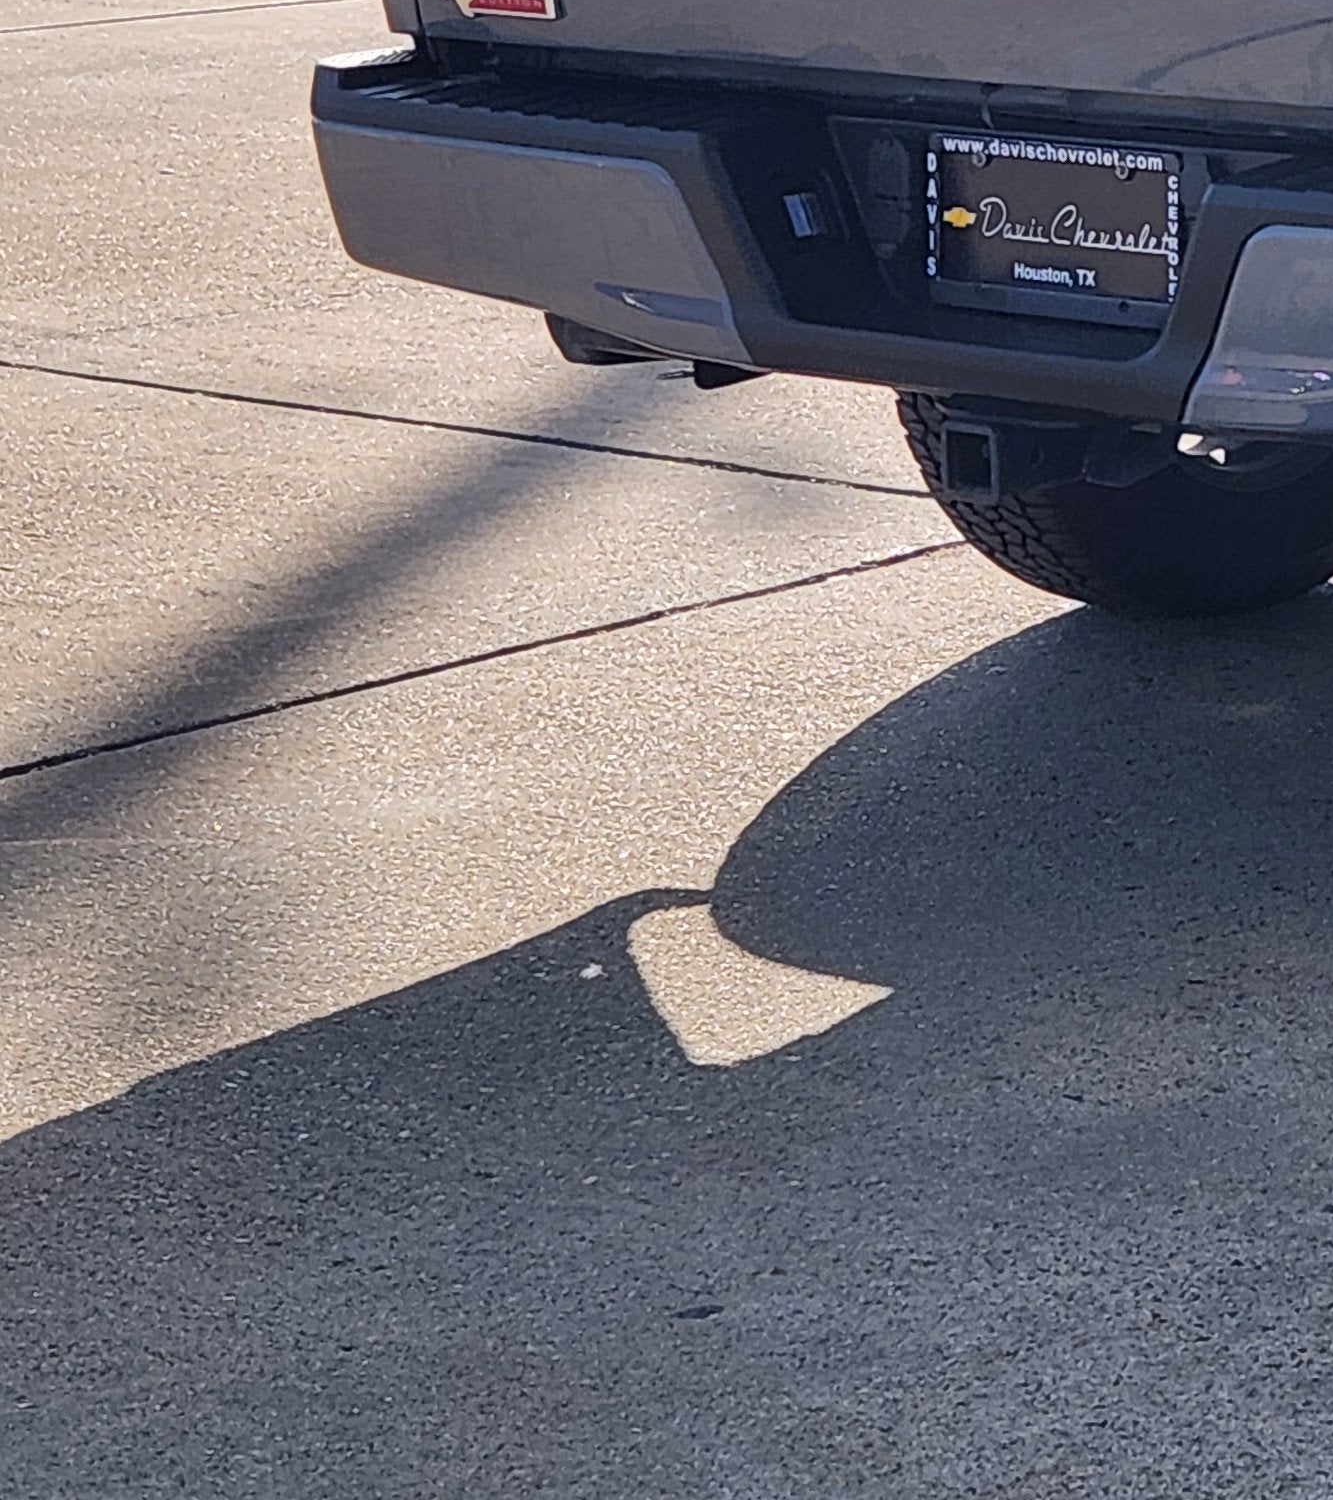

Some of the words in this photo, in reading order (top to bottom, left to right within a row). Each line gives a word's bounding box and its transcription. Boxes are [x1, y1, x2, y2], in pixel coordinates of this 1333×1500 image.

[942, 136, 1164, 172] www.davischevrolet.com
[926, 151, 938, 277] DAVIS
[979, 196, 1050, 244] Davis
[1166, 174, 1179, 303] CHEVROLE
[1013, 261, 1074, 288] Houston,
[1075, 268, 1096, 288] TX
